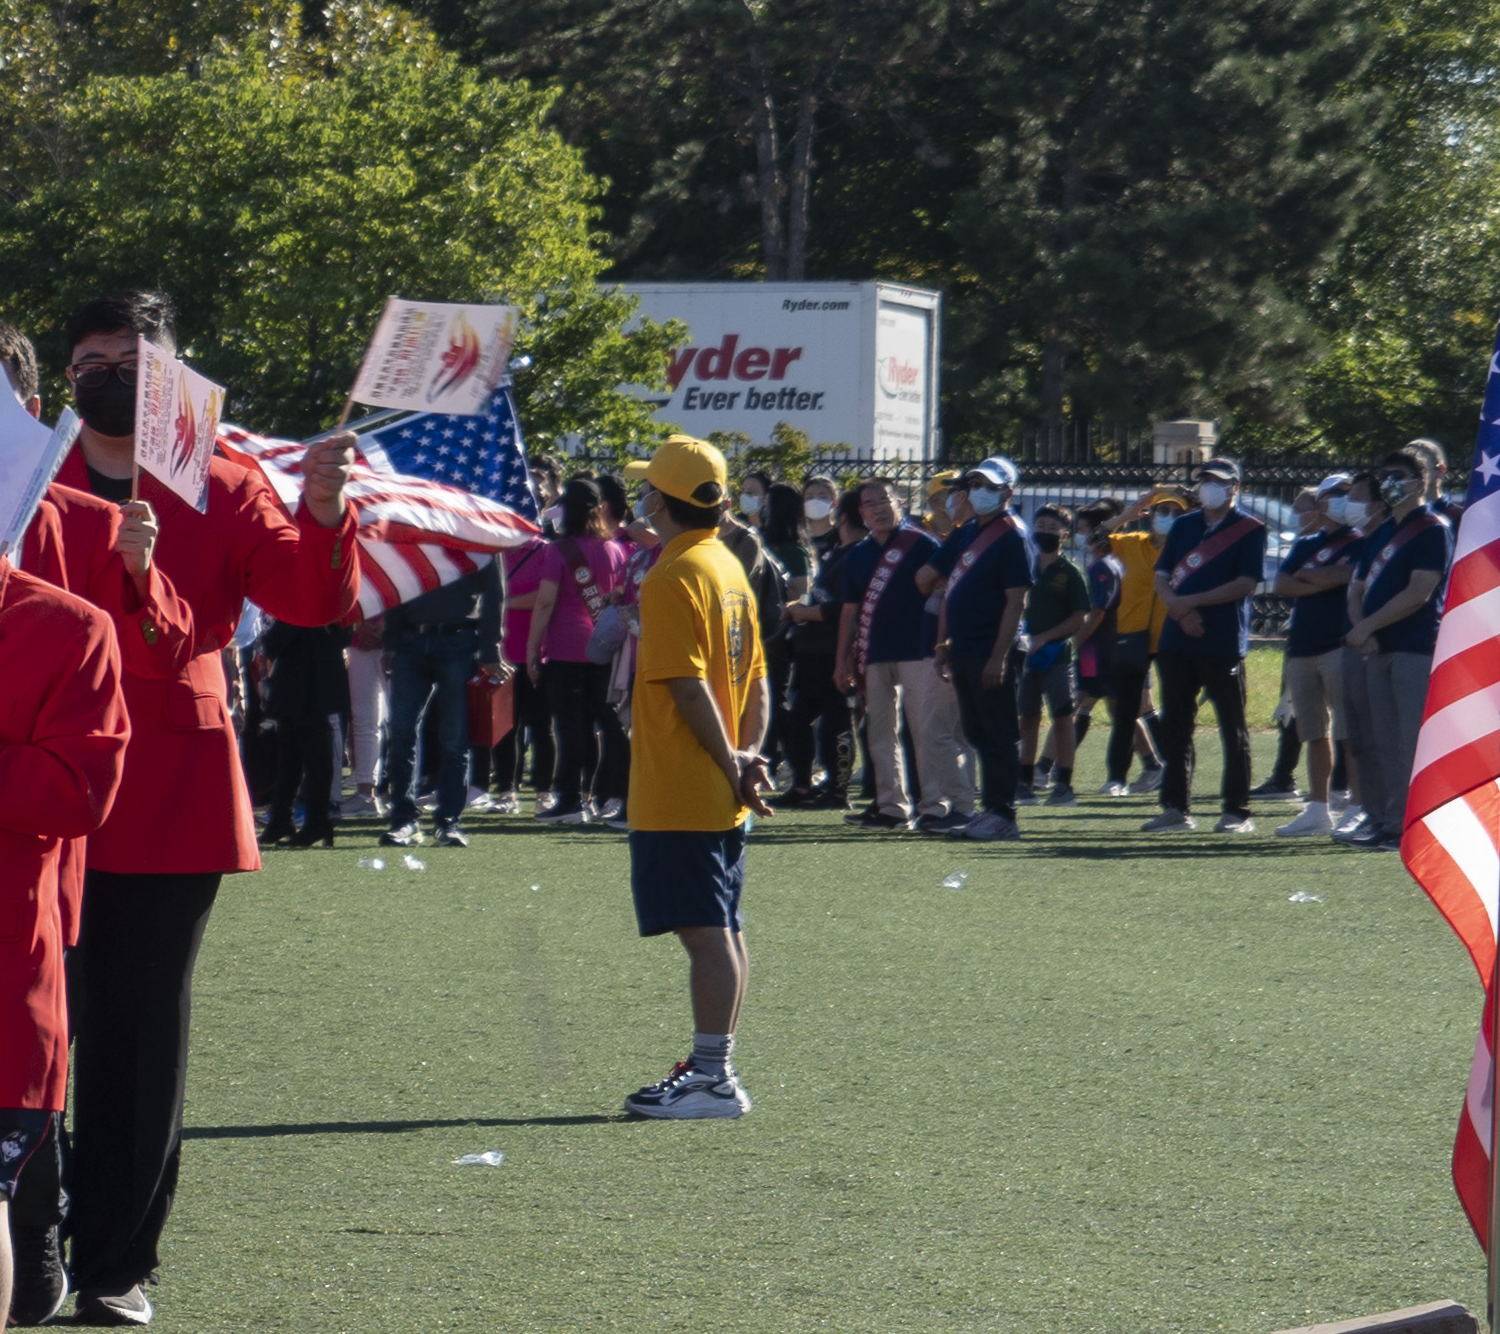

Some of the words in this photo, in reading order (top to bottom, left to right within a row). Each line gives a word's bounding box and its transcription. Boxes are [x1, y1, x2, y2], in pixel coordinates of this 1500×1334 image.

[782, 299, 850, 311] Ryder.com
[666, 334, 802, 392] yder
[682, 387, 741, 410] Ever
[744, 387, 825, 410] better.
